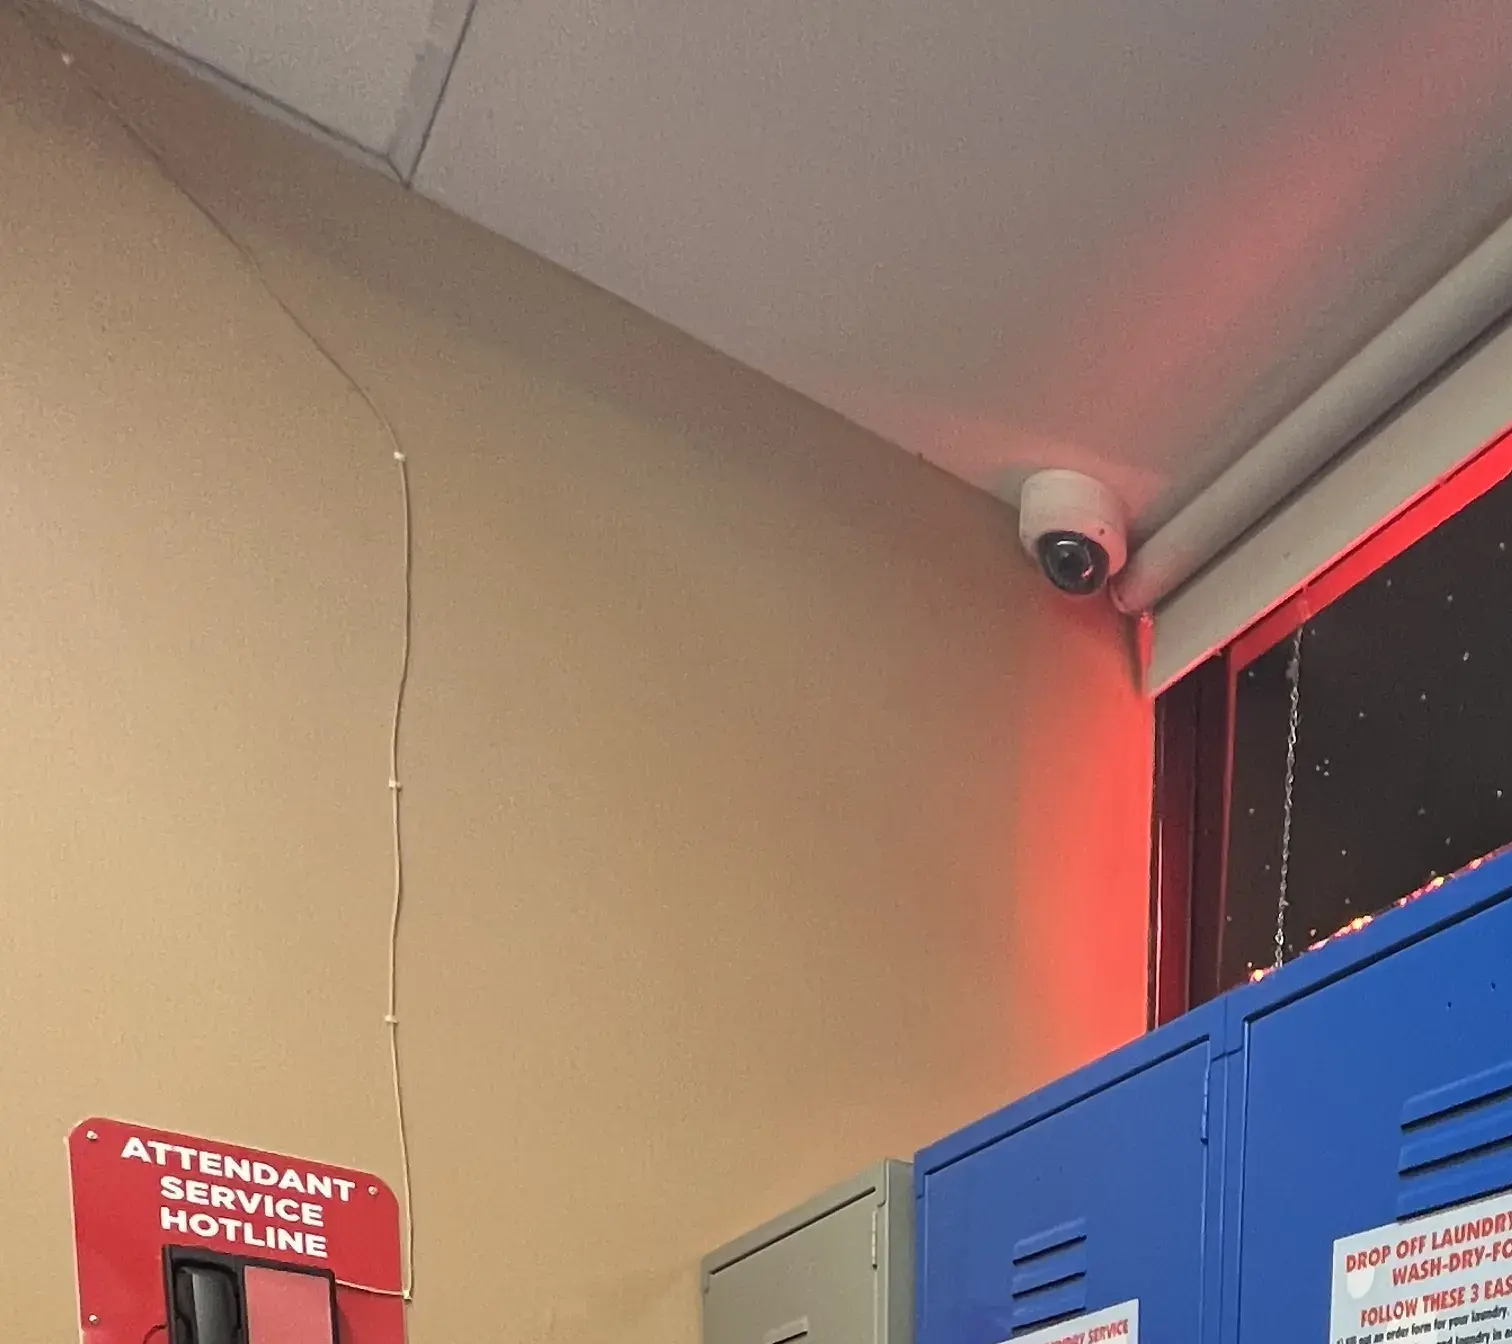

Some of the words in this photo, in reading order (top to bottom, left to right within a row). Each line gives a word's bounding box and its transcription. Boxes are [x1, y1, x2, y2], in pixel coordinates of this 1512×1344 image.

[121, 1136, 356, 1202] ATTENDANT
[160, 1176, 325, 1228] SERVICE
[160, 1207, 328, 1259] HOTLINE
[1345, 1245, 1391, 1273] DROP
[1396, 1235, 1427, 1259] OFF
[1360, 1297, 1418, 1328] FOLLOW
[1422, 1286, 1466, 1315] THESE
[1470, 1283, 1480, 1303] 3
[1387, 1326, 1409, 1341] order
[1411, 1323, 1432, 1335] form
[1449, 1315, 1469, 1330] your
